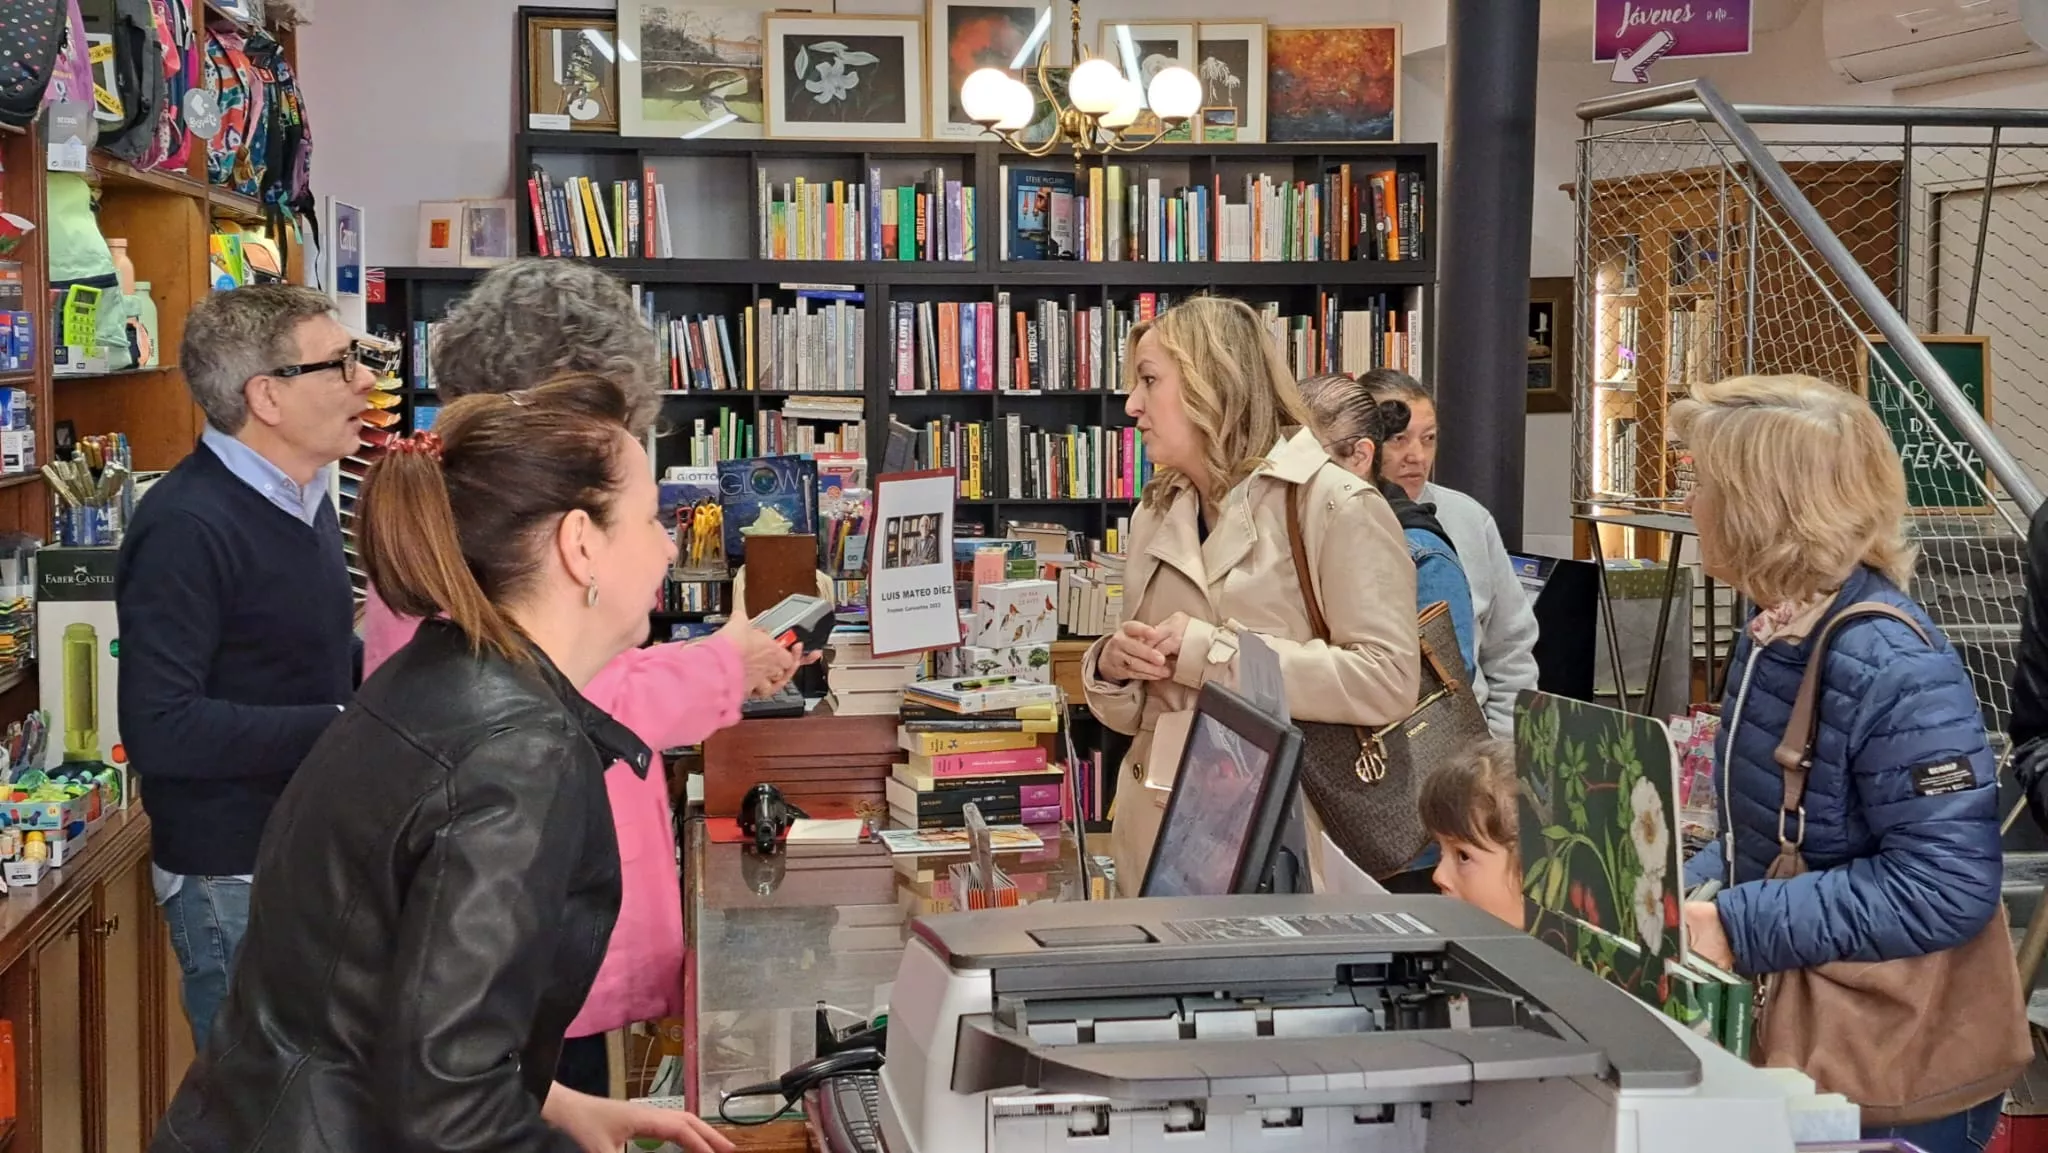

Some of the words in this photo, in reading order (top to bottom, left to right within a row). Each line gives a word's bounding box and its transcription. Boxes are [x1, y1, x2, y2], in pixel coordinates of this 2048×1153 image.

[1616, 1, 1694, 38] Jóvenes
[900, 318, 910, 349] FLOYD
[719, 465, 801, 496] GLOW
[881, 591, 901, 601] LUIS
[902, 588, 931, 599] MATEO
